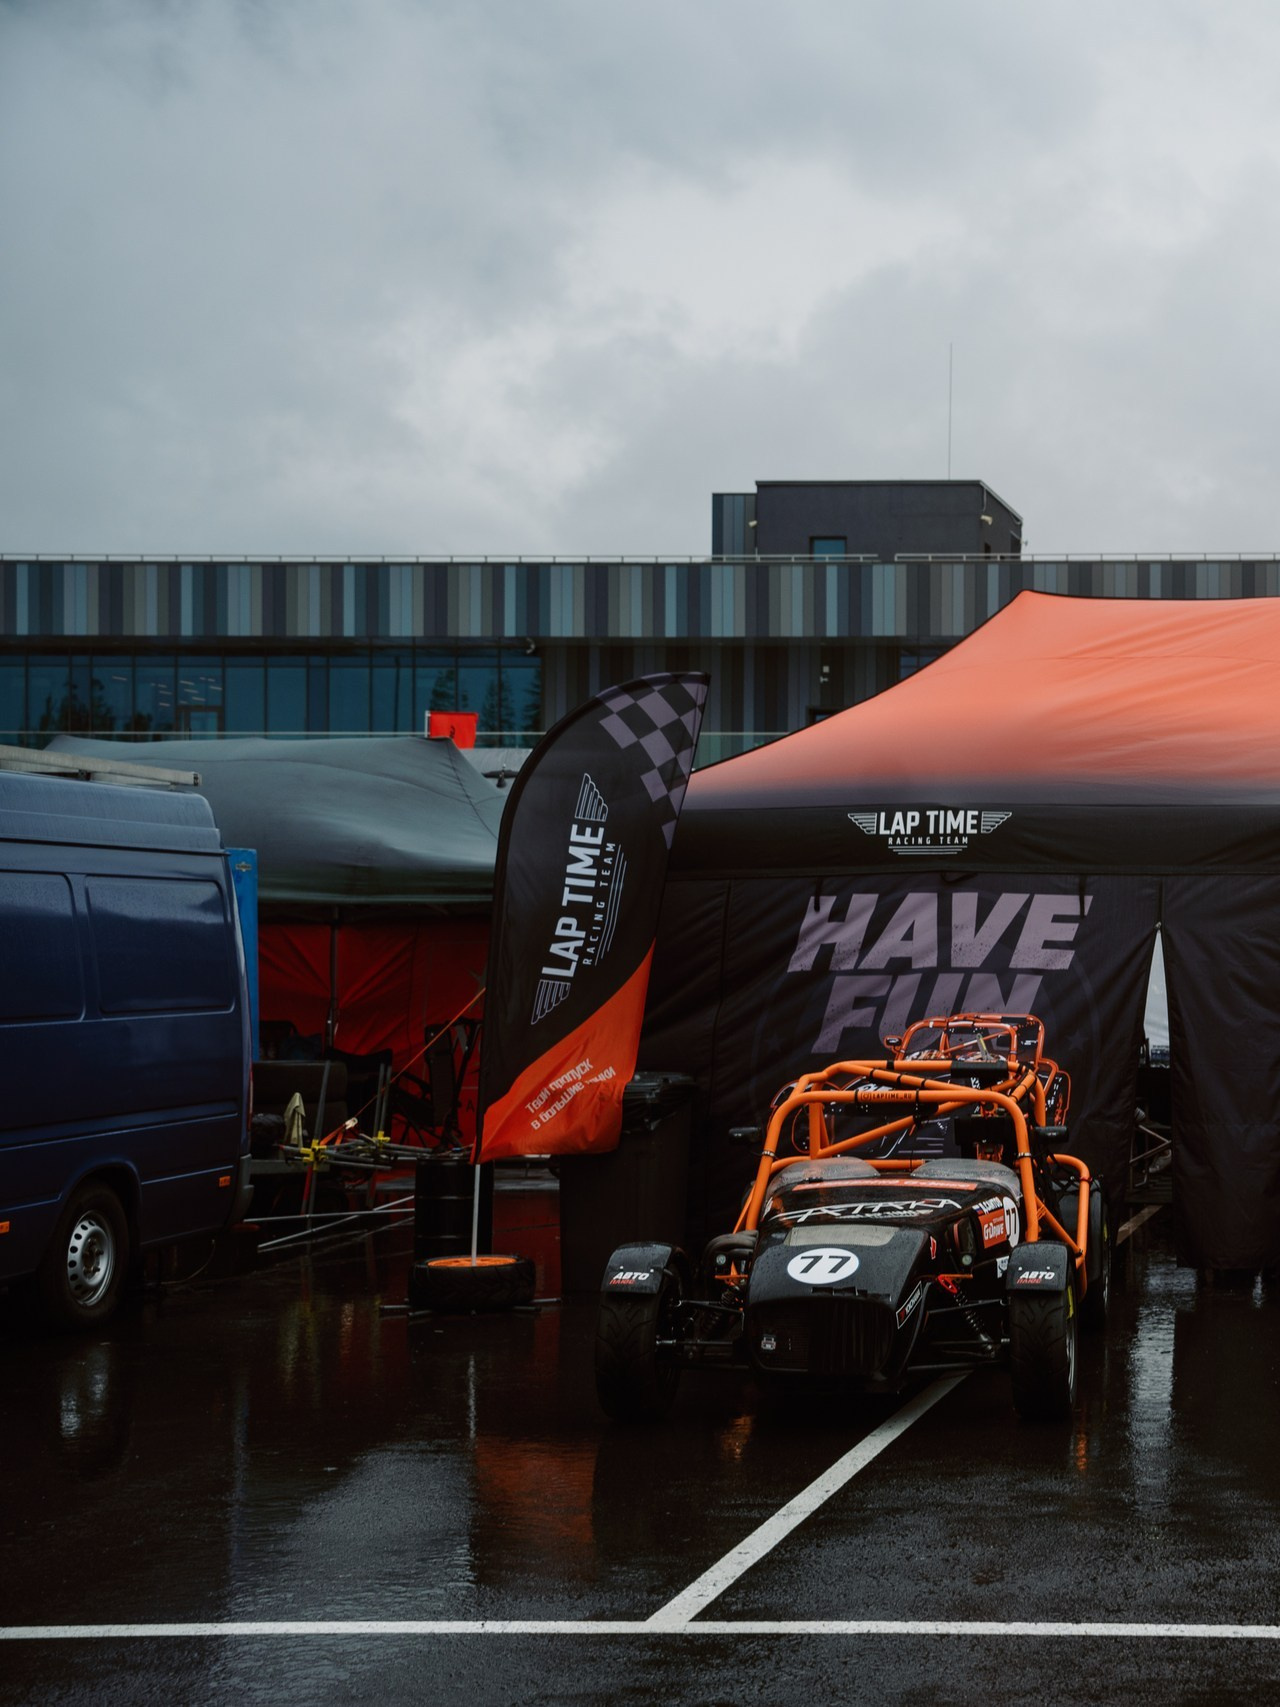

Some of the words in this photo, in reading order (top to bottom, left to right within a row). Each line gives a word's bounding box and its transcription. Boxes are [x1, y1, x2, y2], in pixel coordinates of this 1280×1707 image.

[879, 812, 920, 835] LAP
[926, 810, 979, 835] TIME
[888, 836, 931, 845] RACING
[939, 836, 968, 844] TEAM
[561, 824, 605, 906] TIME
[582, 901, 606, 966] RACING
[599, 842, 616, 888] TEAM
[541, 916, 586, 977] LAP
[787, 892, 1093, 973] HAVE
[811, 973, 1043, 1054] FUN
[525, 1087, 551, 1114] Твой
[549, 1058, 594, 1092] пропуск
[531, 1118, 541, 1130] в
[538, 1081, 585, 1123] большие
[1006, 1207, 1016, 1239] 77
[613, 1271, 649, 1280] АВТО
[800, 1255, 851, 1274] 77
[1020, 1270, 1055, 1280] АВТО
